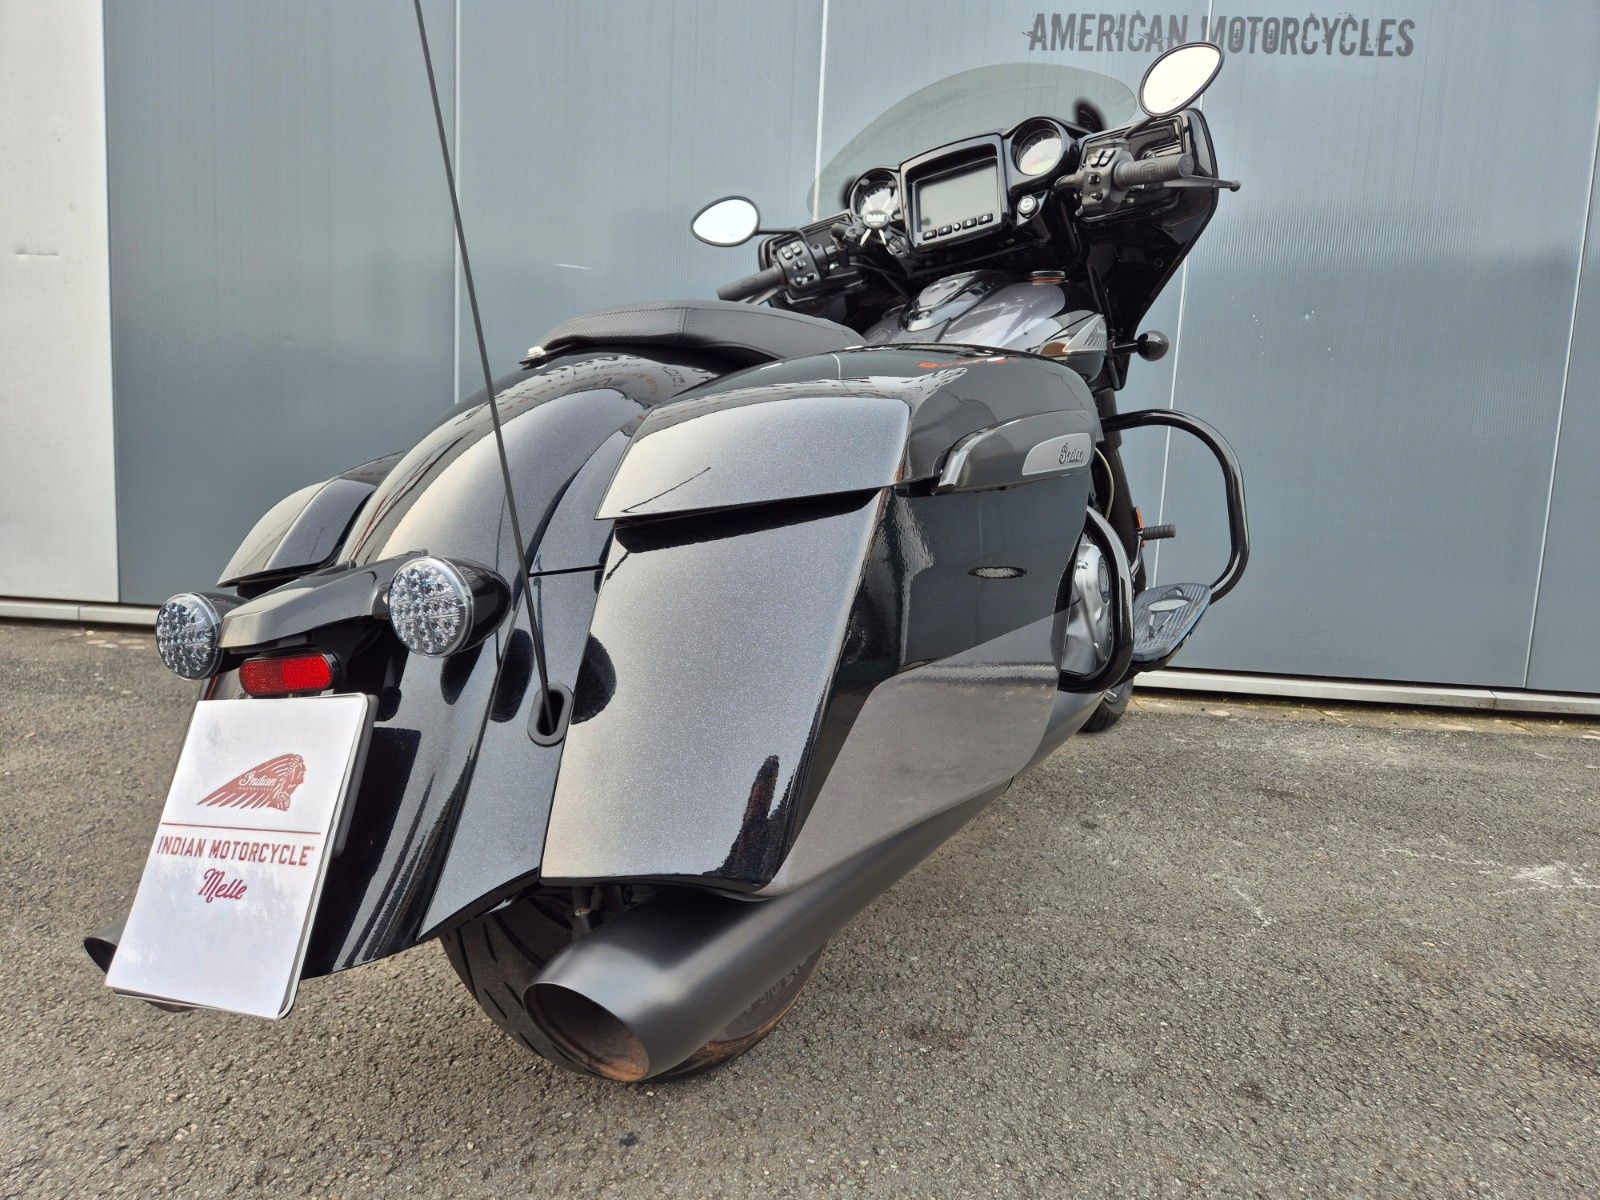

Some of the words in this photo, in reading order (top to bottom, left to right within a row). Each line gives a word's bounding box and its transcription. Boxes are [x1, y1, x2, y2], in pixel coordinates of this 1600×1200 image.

[1026, 12, 1188, 52] AMERICAN
[1201, 14, 1415, 57] MOTORCYCLES
[239, 770, 277, 786] Indian
[156, 836, 206, 857] INDIAN
[209, 840, 311, 866] MOTORCYCLE
[198, 867, 247, 903] Melle
